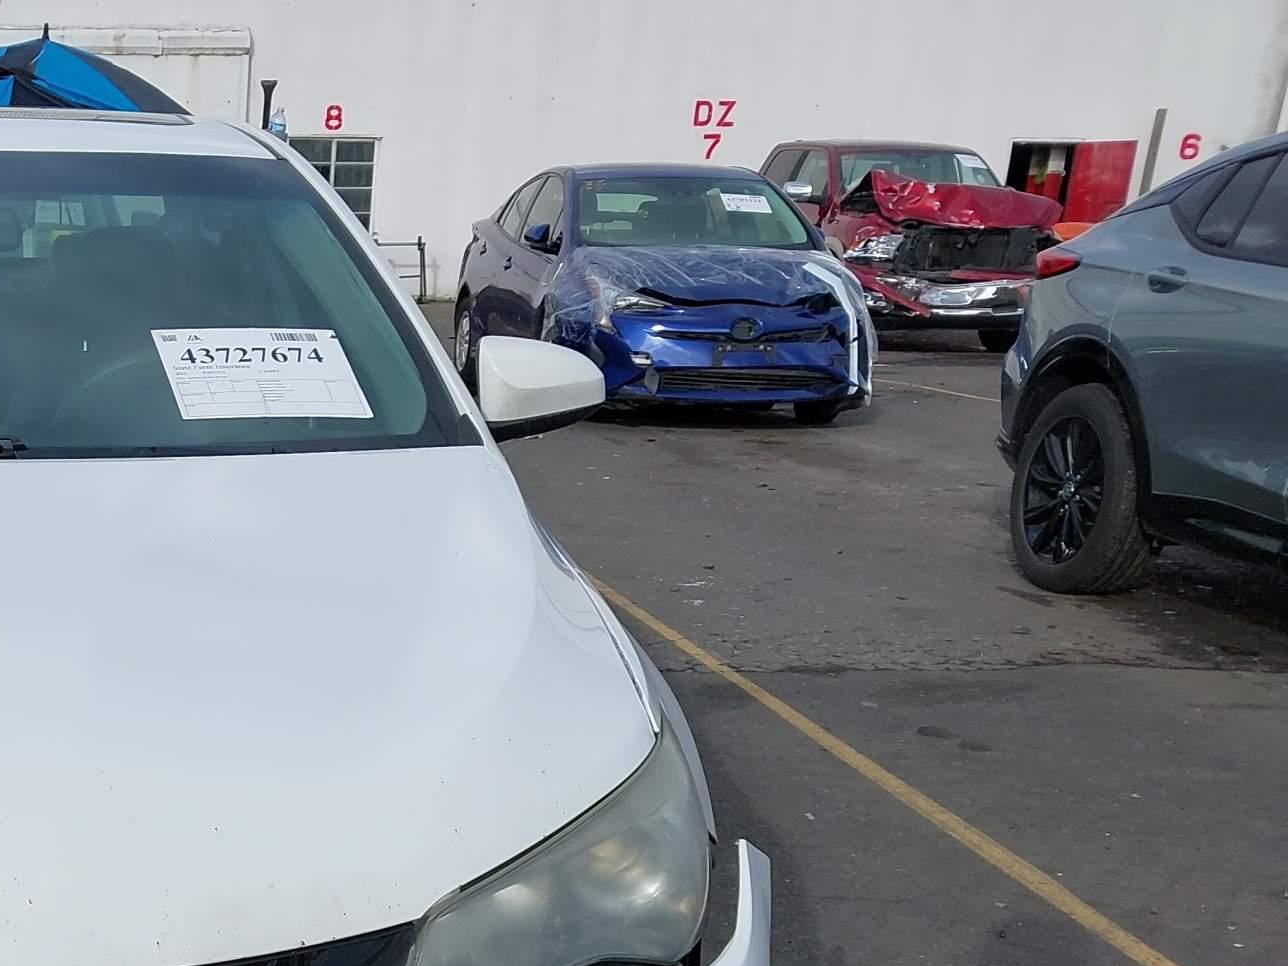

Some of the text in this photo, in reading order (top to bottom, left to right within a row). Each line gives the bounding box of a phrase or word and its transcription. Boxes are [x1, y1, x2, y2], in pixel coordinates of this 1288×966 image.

[324, 104, 343, 131] 8
[693, 100, 737, 127] DZ
[703, 133, 721, 160] 7
[1180, 133, 1202, 160] 6
[180, 347, 324, 364] 43727674
